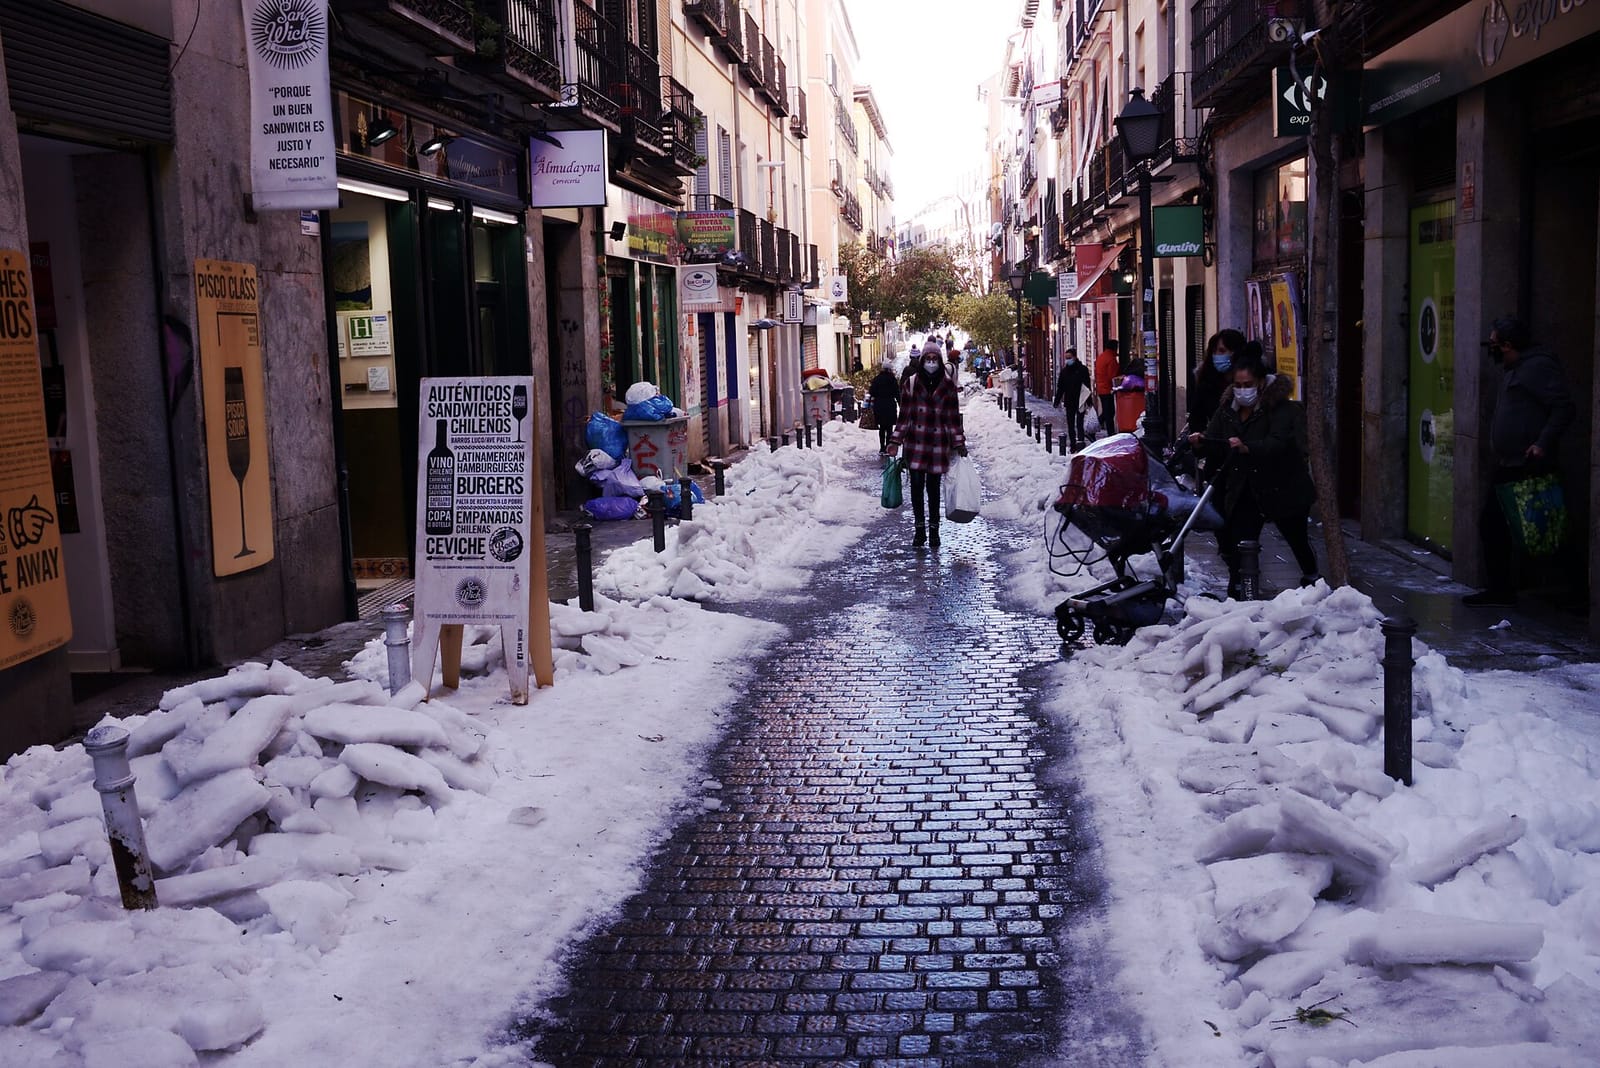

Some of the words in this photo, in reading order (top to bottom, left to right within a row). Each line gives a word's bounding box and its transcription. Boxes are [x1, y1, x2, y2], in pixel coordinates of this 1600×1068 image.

[263, 20, 311, 44] Wich
[272, 103, 285, 116] UN
[287, 102, 313, 115] BUEN
[262, 121, 310, 134] SANDWICH
[312, 120, 325, 132] ES
[277, 140, 303, 152] JUSTO
[305, 139, 312, 150] Y
[534, 159, 601, 177] Almudayna
[197, 273, 226, 298] PISCO
[228, 275, 256, 300] CLASS
[350, 317, 373, 339] H
[428, 381, 511, 401] AUTÉNTICOS
[226, 402, 244, 419] PISCO
[427, 402, 511, 417] SANDWICHES
[227, 419, 247, 440] SOUR
[450, 418, 511, 433] CHILENOS
[430, 456, 453, 468] VINO
[457, 451, 524, 462] LATINAMERICAN
[456, 462, 524, 472] HAMBURGUESAS
[456, 476, 523, 494] BURGERS
[427, 510, 451, 521] COPA
[455, 510, 523, 523] EMPANADAS
[455, 524, 491, 534] CHILENAS
[426, 537, 486, 554] CEVICHE
[15, 546, 59, 589] AWAY
